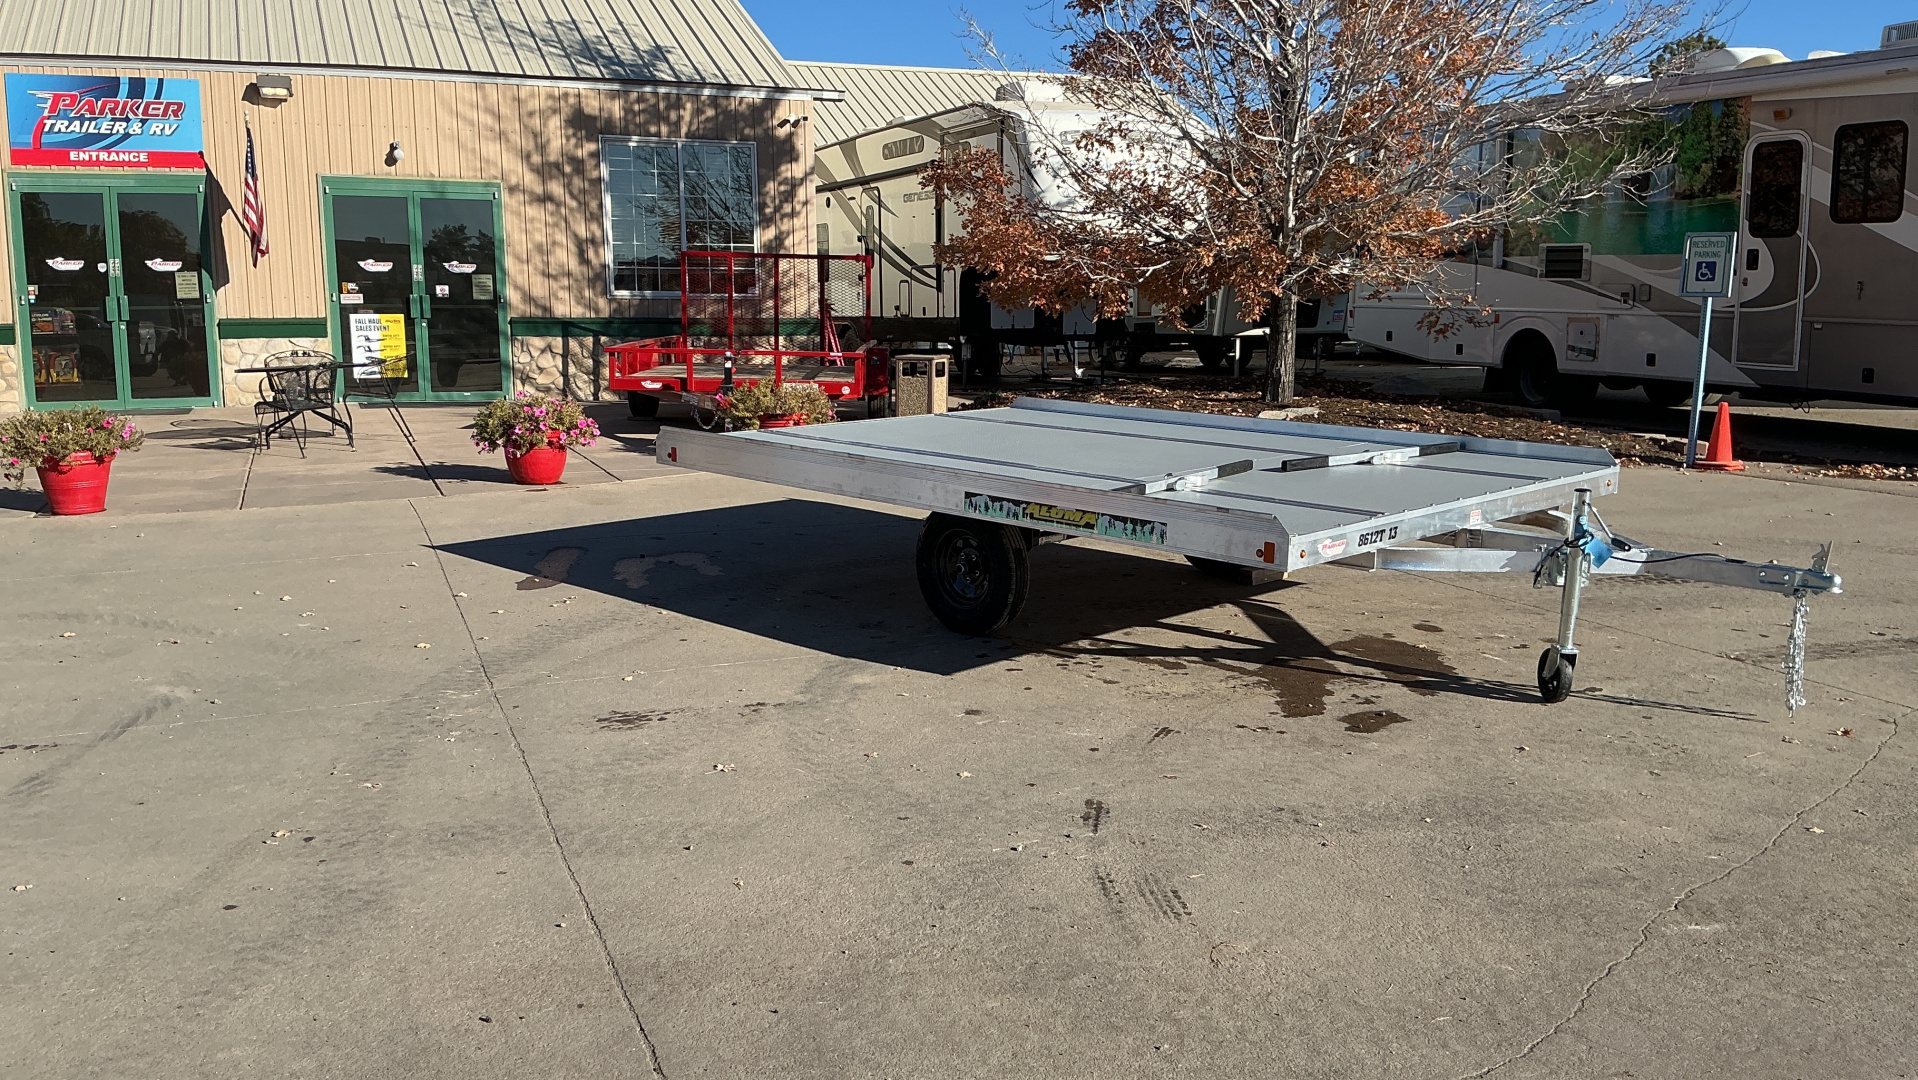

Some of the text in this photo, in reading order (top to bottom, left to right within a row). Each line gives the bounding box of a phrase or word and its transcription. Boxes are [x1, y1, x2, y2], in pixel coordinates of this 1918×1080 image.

[44, 91, 186, 120] PARKER
[43, 119, 178, 136] TRAILER & RV
[69, 151, 149, 162] ENTRANCE
[1692, 240, 1726, 249] RESERVED
[1694, 250, 1722, 259] PARKING
[1025, 503, 1097, 526] ALUMA
[1357, 526, 1399, 547] 8612T 13
